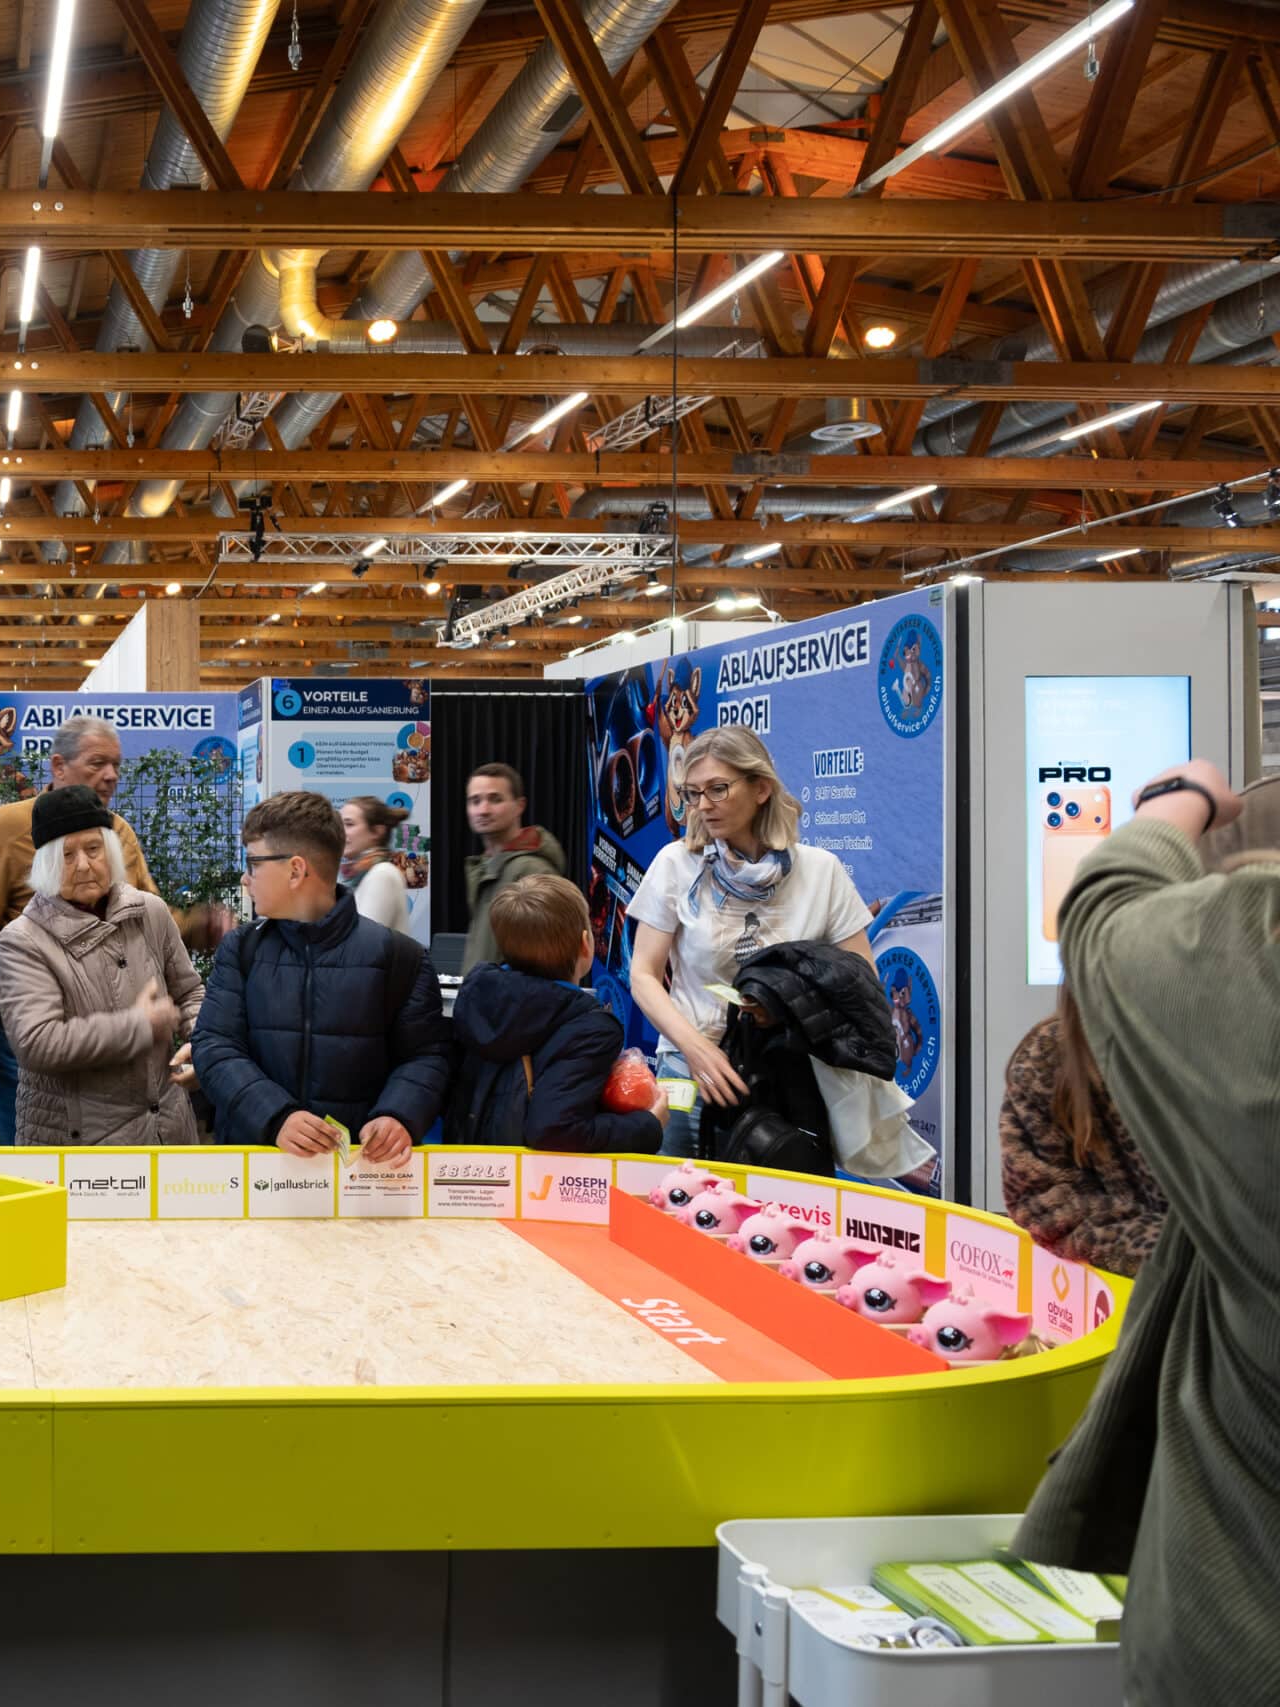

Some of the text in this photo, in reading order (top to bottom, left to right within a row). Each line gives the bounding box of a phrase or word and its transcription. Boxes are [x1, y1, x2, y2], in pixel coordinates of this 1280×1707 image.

[718, 623, 868, 691] ABLAUFSERVICE
[280, 691, 369, 712] 6 VORTEILE
[880, 675, 942, 733] ablaufservice-profi.ch
[303, 706, 419, 715] EINER ABLAUFSANIERUNG
[719, 697, 769, 731] PROFI
[297, 747, 305, 763] 1
[814, 748, 863, 777] VORTEILE:
[1039, 767, 1111, 783] PRO
[831, 785, 856, 799] Service
[815, 811, 839, 825] Schnell
[853, 811, 865, 824] Ort
[844, 836, 872, 850] Technik
[437, 1164, 507, 1178] EBERLE
[274, 1178, 329, 1192] gallusbrick
[559, 1176, 607, 1189] JOSEPH
[560, 1187, 607, 1199] WIZARD
[951, 1240, 1002, 1276] COFOX
[1047, 1300, 1073, 1324] obvita
[621, 1298, 727, 1345] Start
